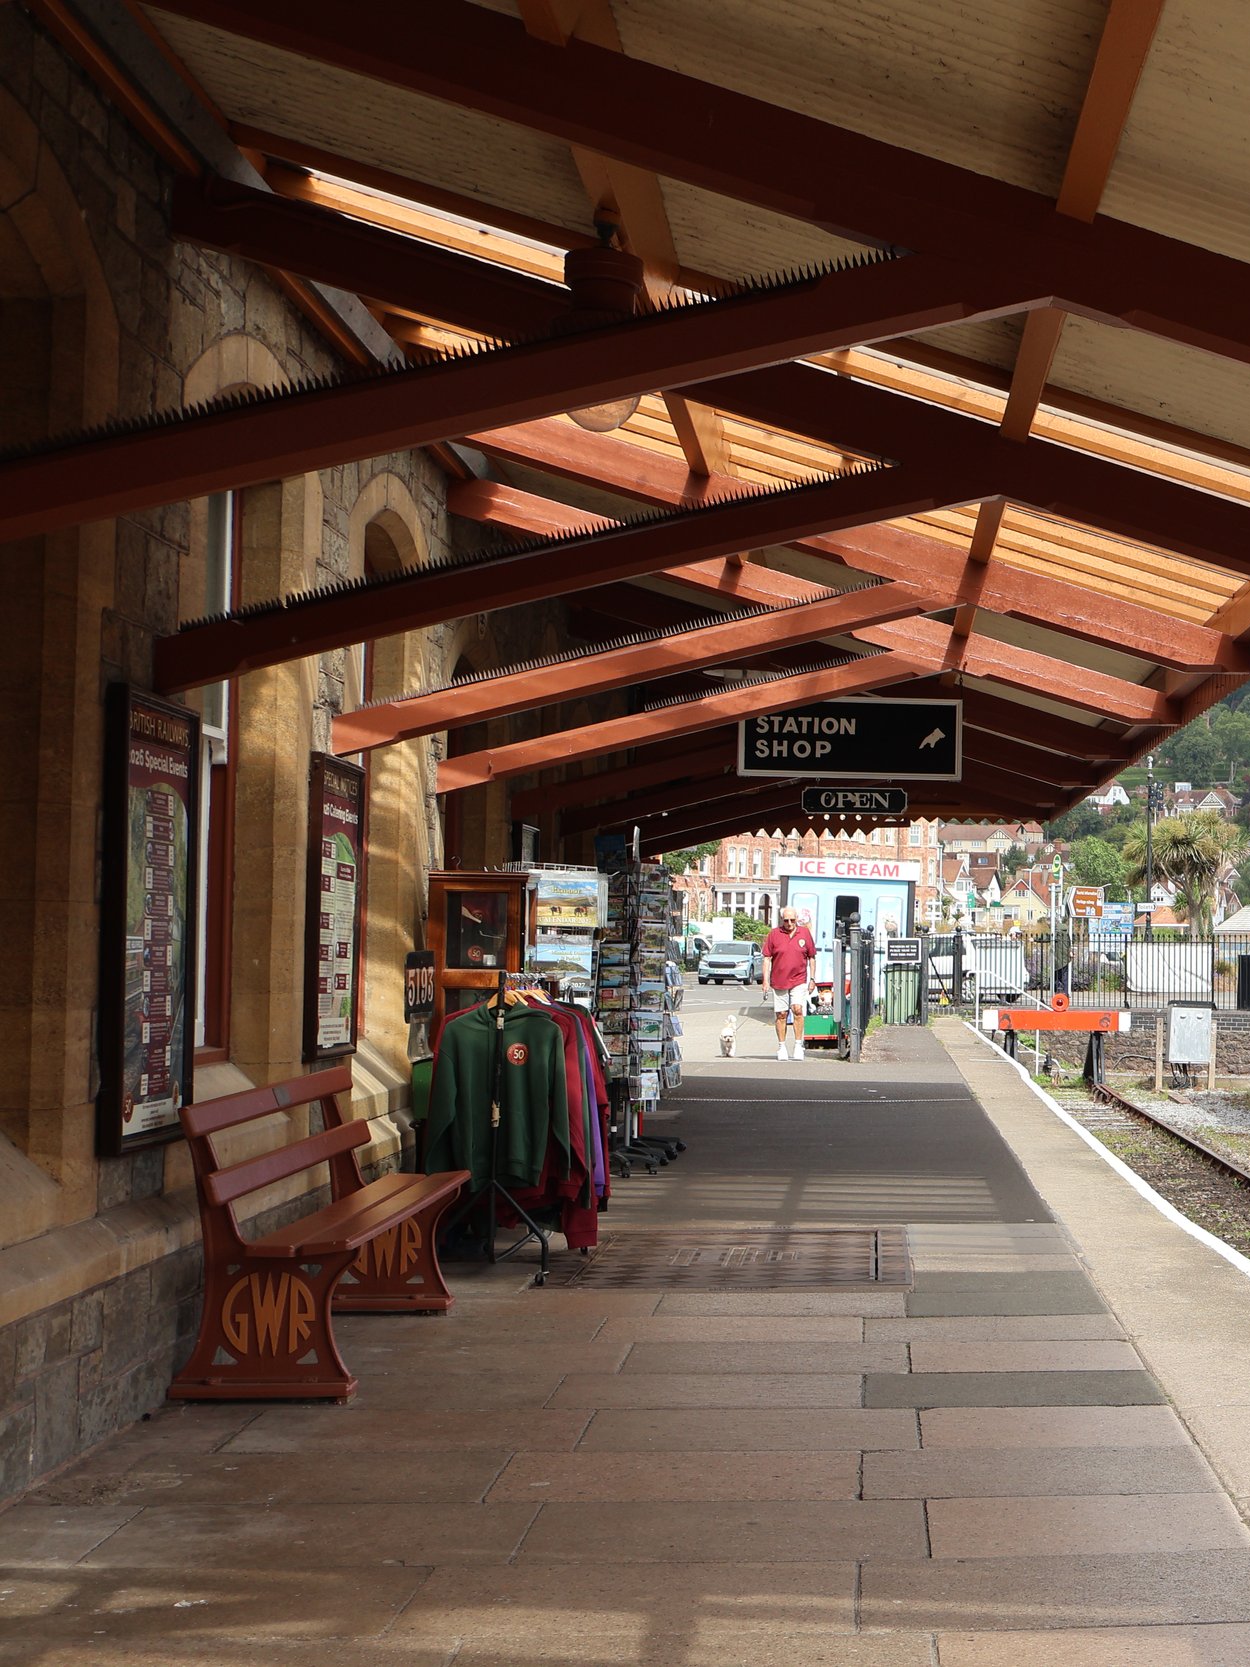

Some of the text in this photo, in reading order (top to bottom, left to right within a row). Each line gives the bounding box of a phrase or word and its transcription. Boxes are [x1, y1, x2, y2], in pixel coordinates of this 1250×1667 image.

[755, 716, 856, 735] STATION
[754, 739, 832, 758] SHOP
[129, 748, 188, 778] 026 Special Events
[820, 791, 891, 809] OPEN
[345, 808, 359, 825] Events
[799, 860, 900, 878] ICE CREAM
[472, 949, 481, 957] 50
[408, 966, 434, 1006] 5193
[513, 1049, 525, 1060] 50
[221, 1271, 316, 1357] GWR
